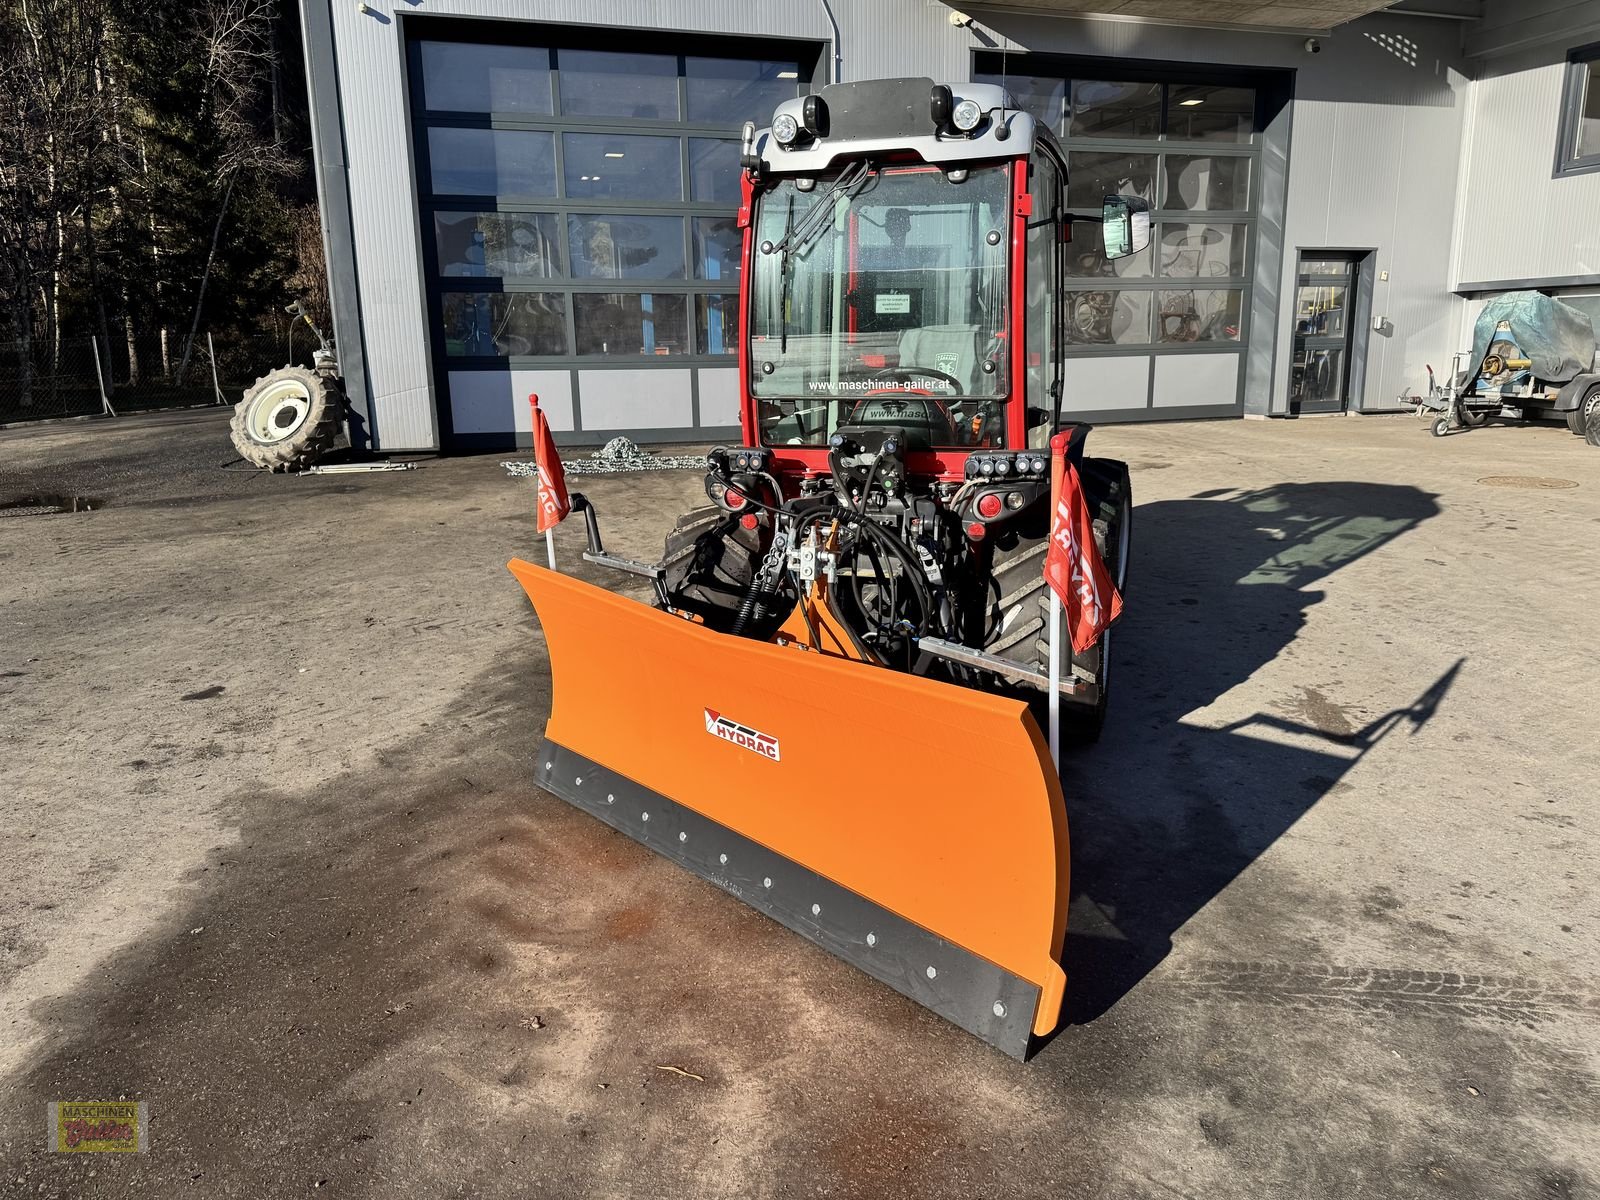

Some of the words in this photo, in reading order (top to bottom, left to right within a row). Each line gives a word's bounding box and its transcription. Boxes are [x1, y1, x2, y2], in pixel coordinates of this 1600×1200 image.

[809, 379, 950, 391] www.maschinen-gailer.at
[870, 410, 929, 418] www.masc
[717, 725, 776, 758] HYDRAC
